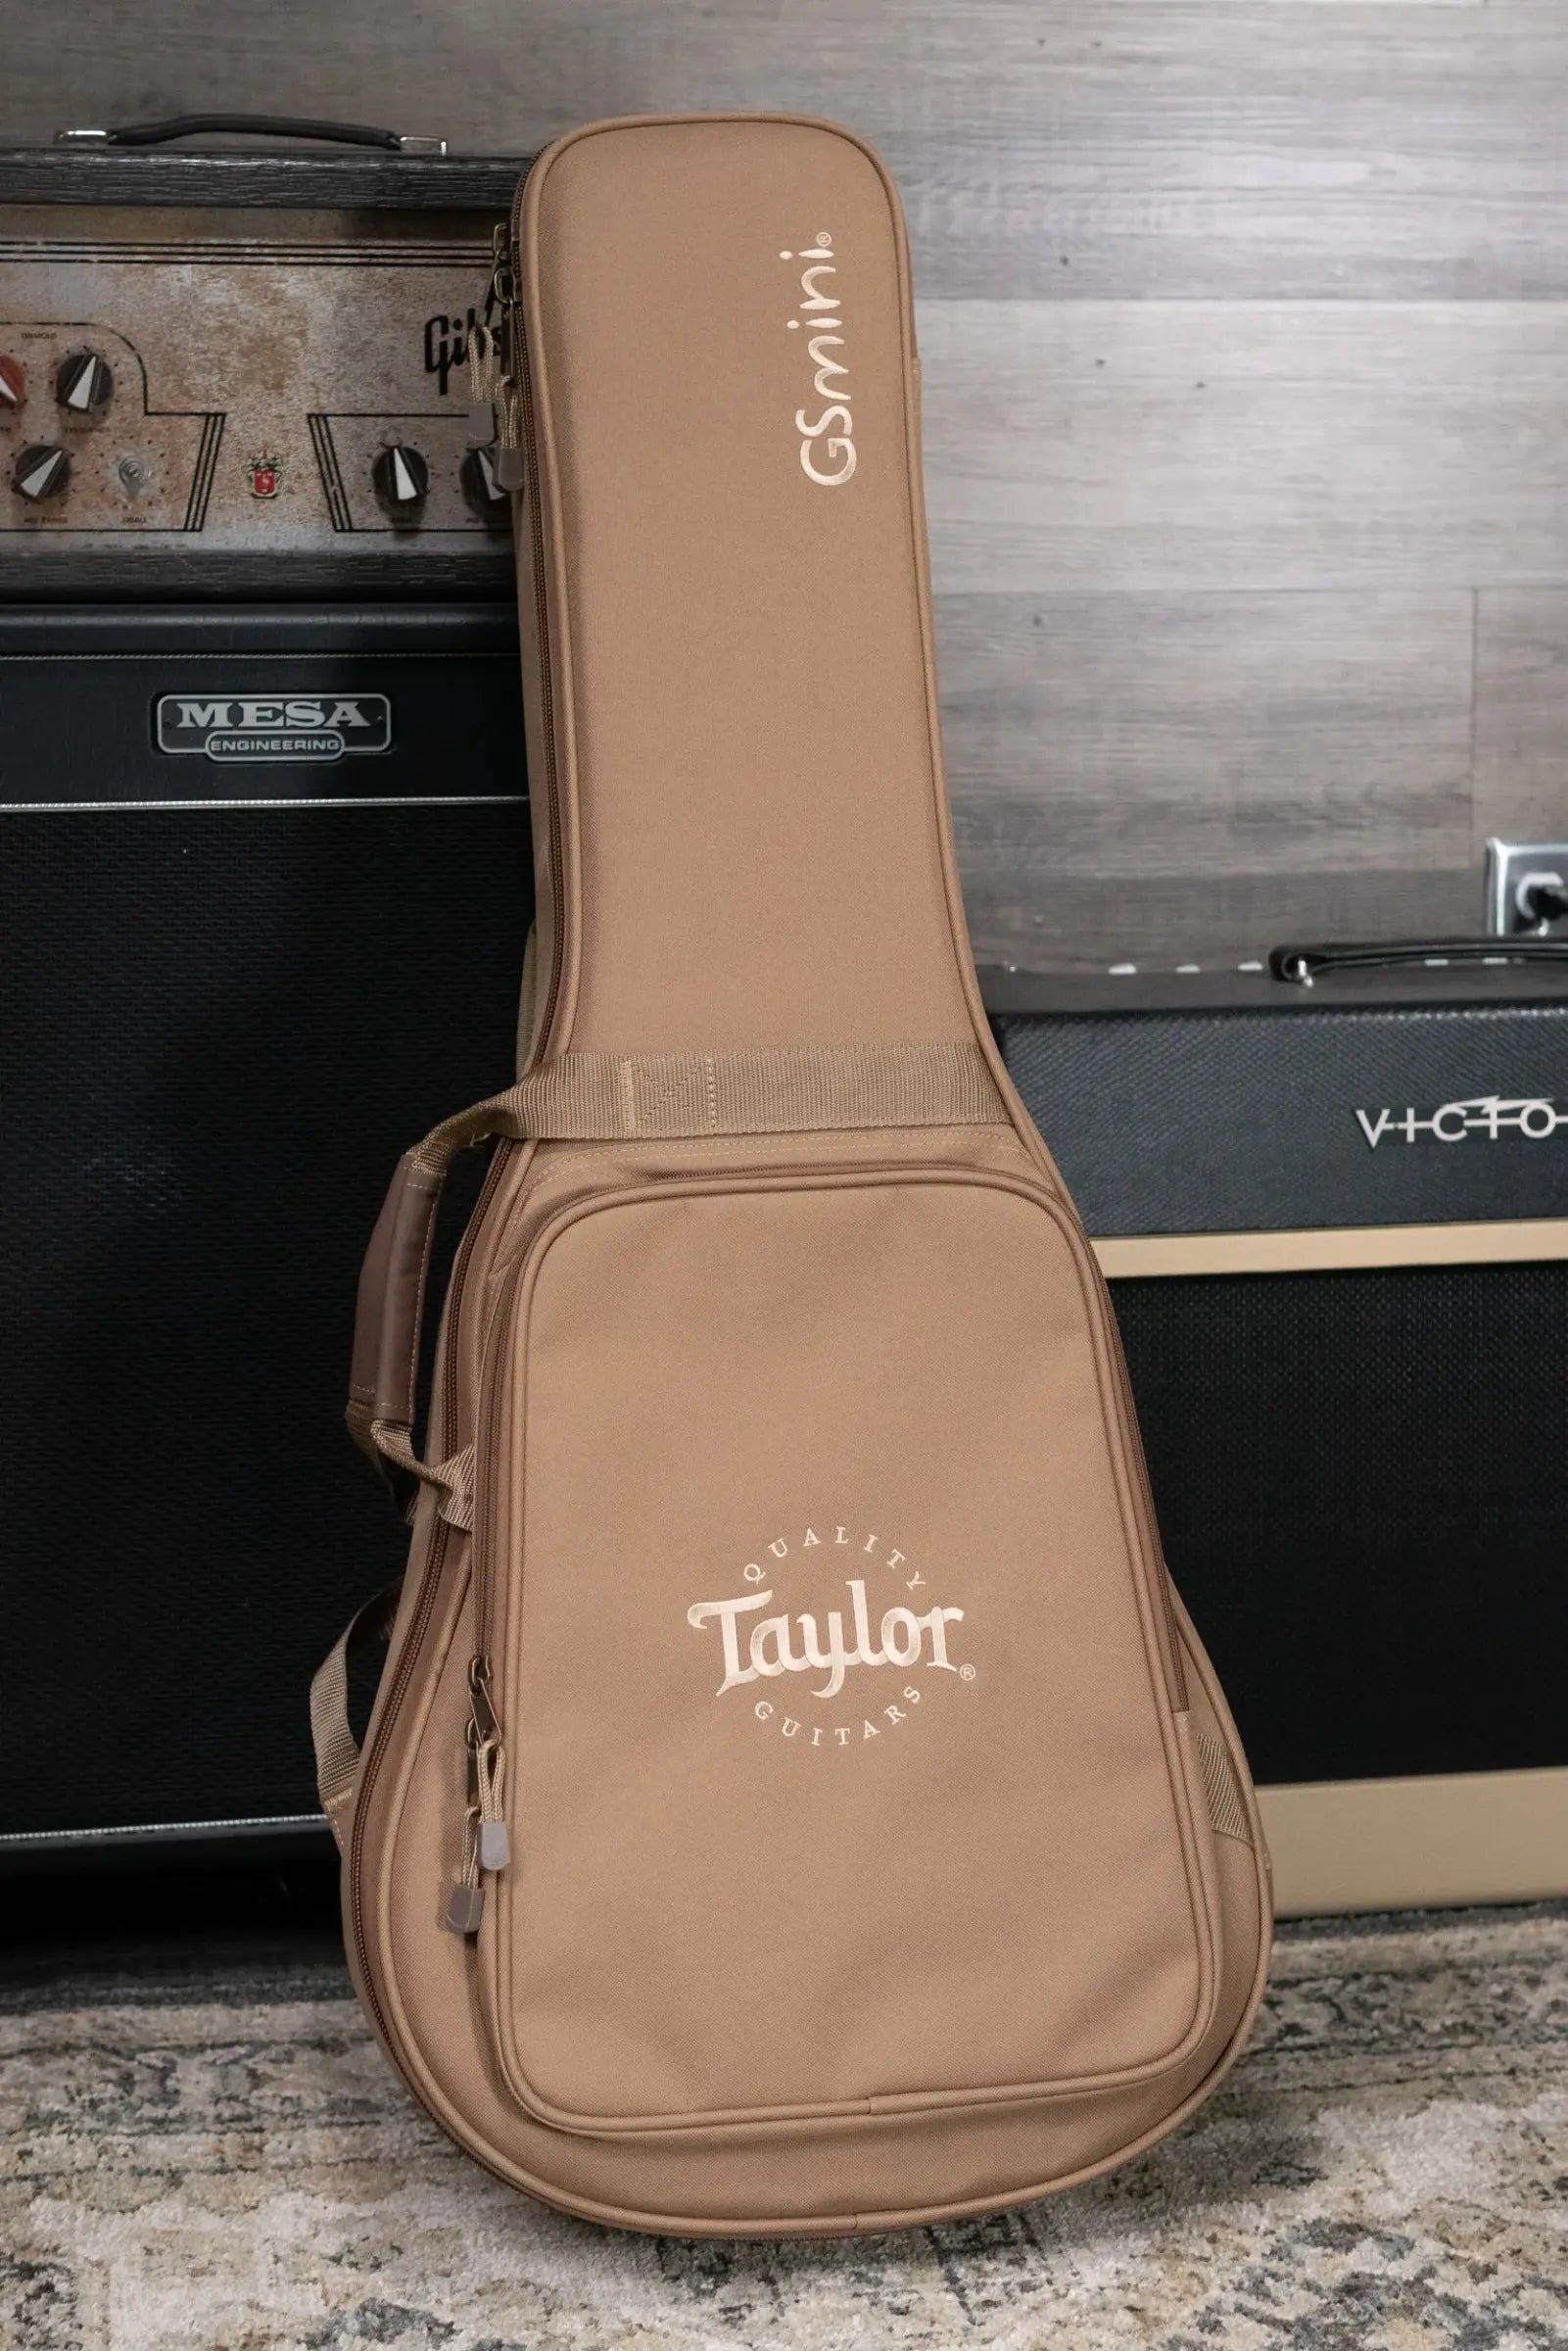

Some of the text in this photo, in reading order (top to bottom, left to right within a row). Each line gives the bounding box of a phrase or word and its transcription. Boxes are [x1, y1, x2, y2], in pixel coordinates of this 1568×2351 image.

[176, 700, 371, 728] MESA
[210, 740, 342, 752] ENGINEERING
[743, 1526, 927, 1585] QUALITY
[754, 1686, 921, 1747] GUITARS
